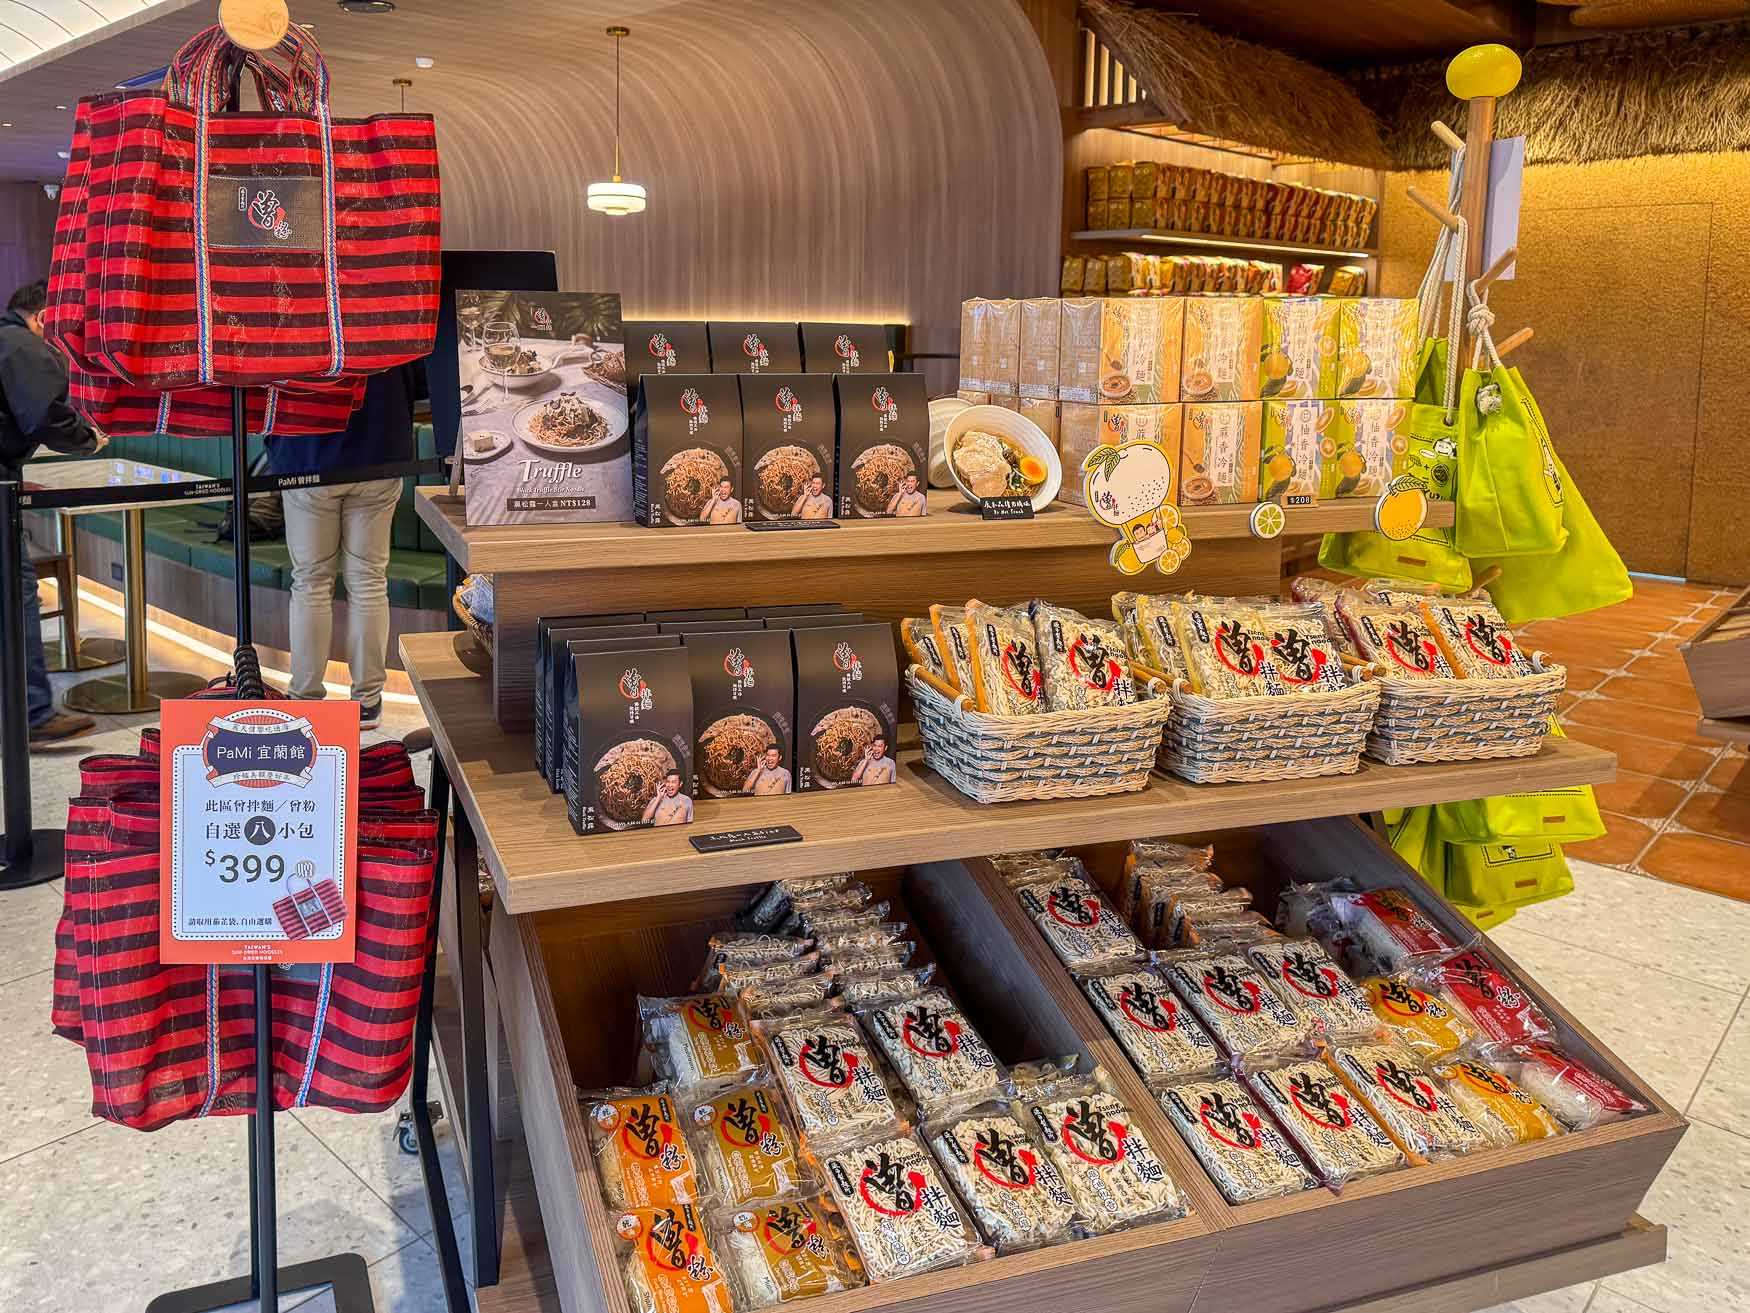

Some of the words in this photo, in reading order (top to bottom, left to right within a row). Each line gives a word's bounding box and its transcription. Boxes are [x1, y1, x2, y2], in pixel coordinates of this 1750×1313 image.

[278, 478, 296, 487] PaMi
[519, 459, 583, 483] Truffle
[1290, 496, 1310, 504] $208
[217, 746, 252, 759] PaMi
[257, 745, 305, 760] 宜蘭館
[205, 848, 284, 884] $399
[852, 1066, 887, 1103] 拌麵
[660, 1144, 686, 1170] 粉
[760, 1133, 785, 1156] 粉
[1123, 1137, 1165, 1184] 拌麵
[1035, 1165, 1074, 1206] 拌麵
[921, 1186, 960, 1232] 拌麵
[688, 1254, 713, 1281] 粉
